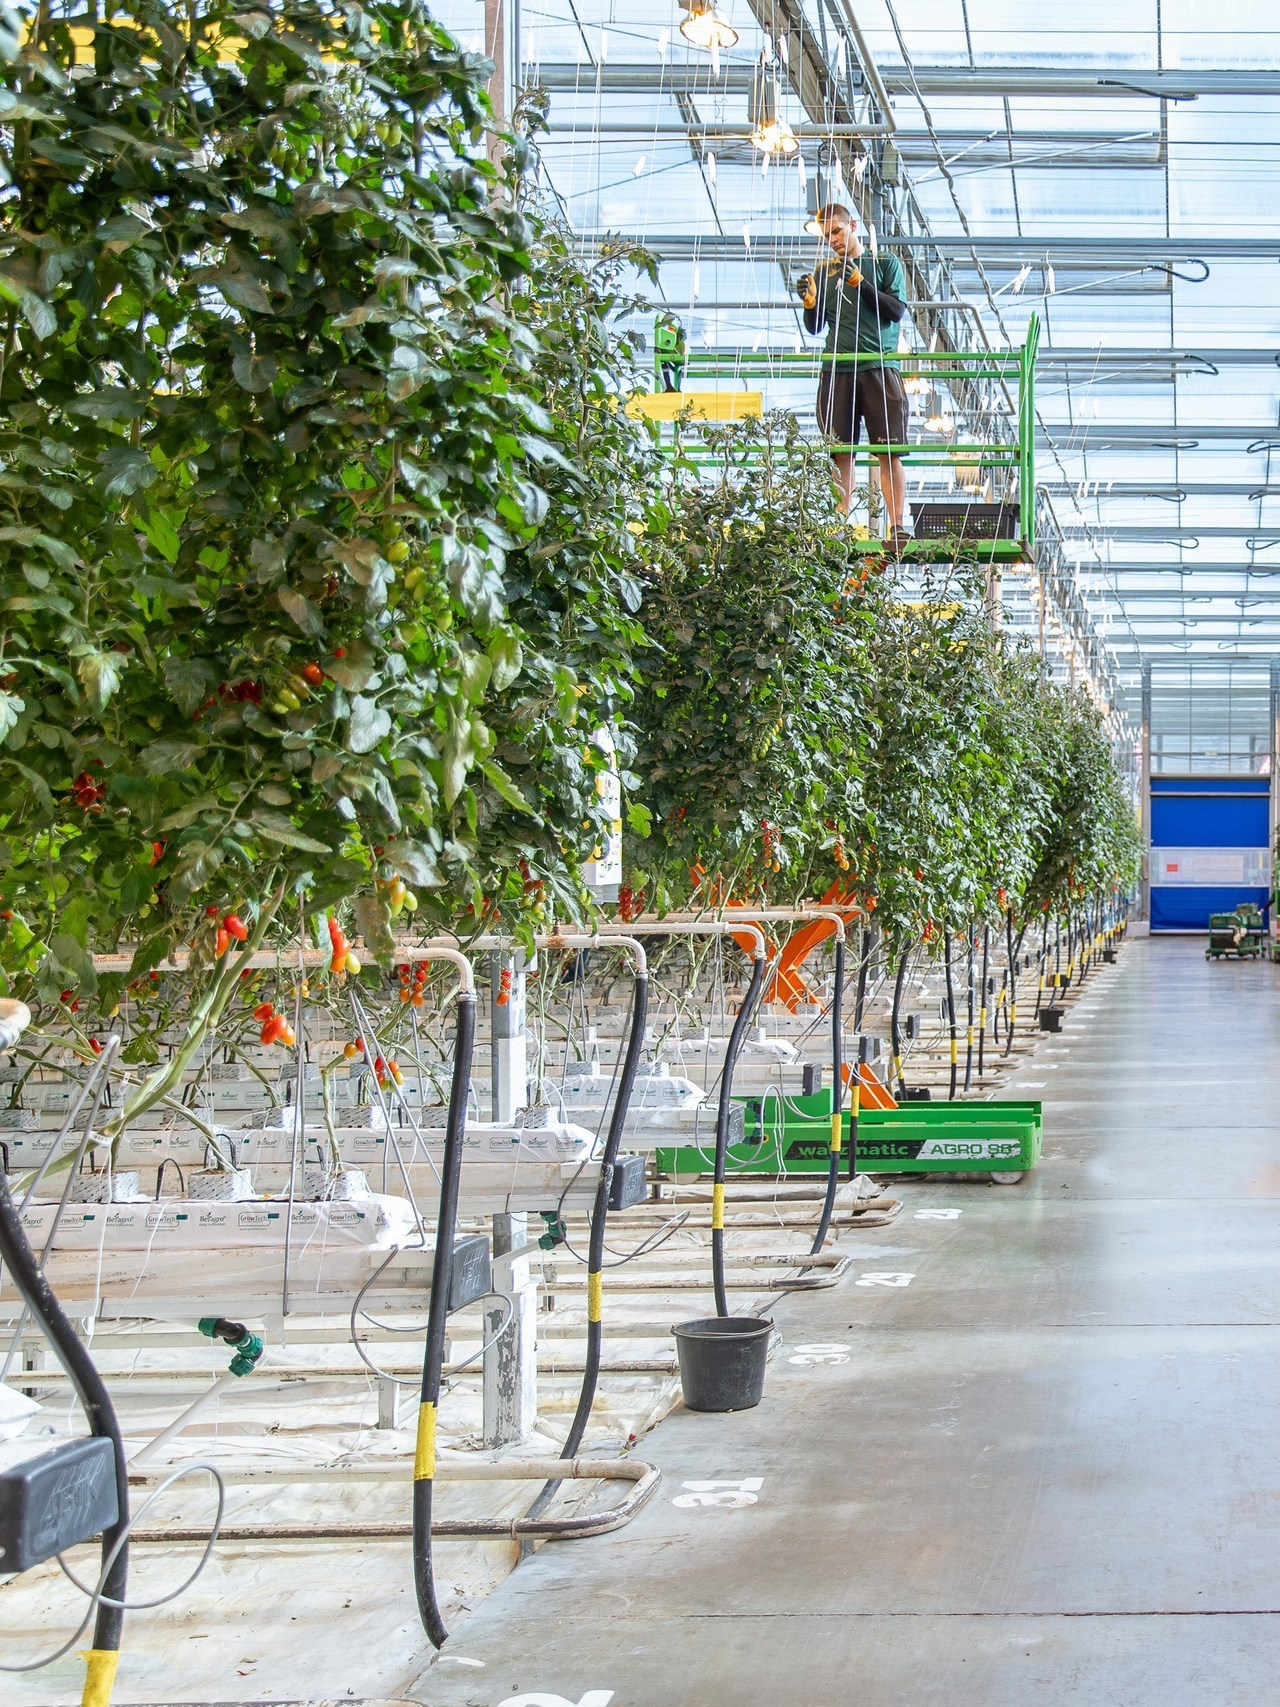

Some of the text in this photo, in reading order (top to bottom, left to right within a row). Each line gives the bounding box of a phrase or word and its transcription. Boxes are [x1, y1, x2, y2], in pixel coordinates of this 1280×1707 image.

[798, 1144, 909, 1156] wazmatic
[930, 1143, 982, 1155] AGRO
[787, 1343, 852, 1366] 30
[671, 1477, 765, 1508] 31
